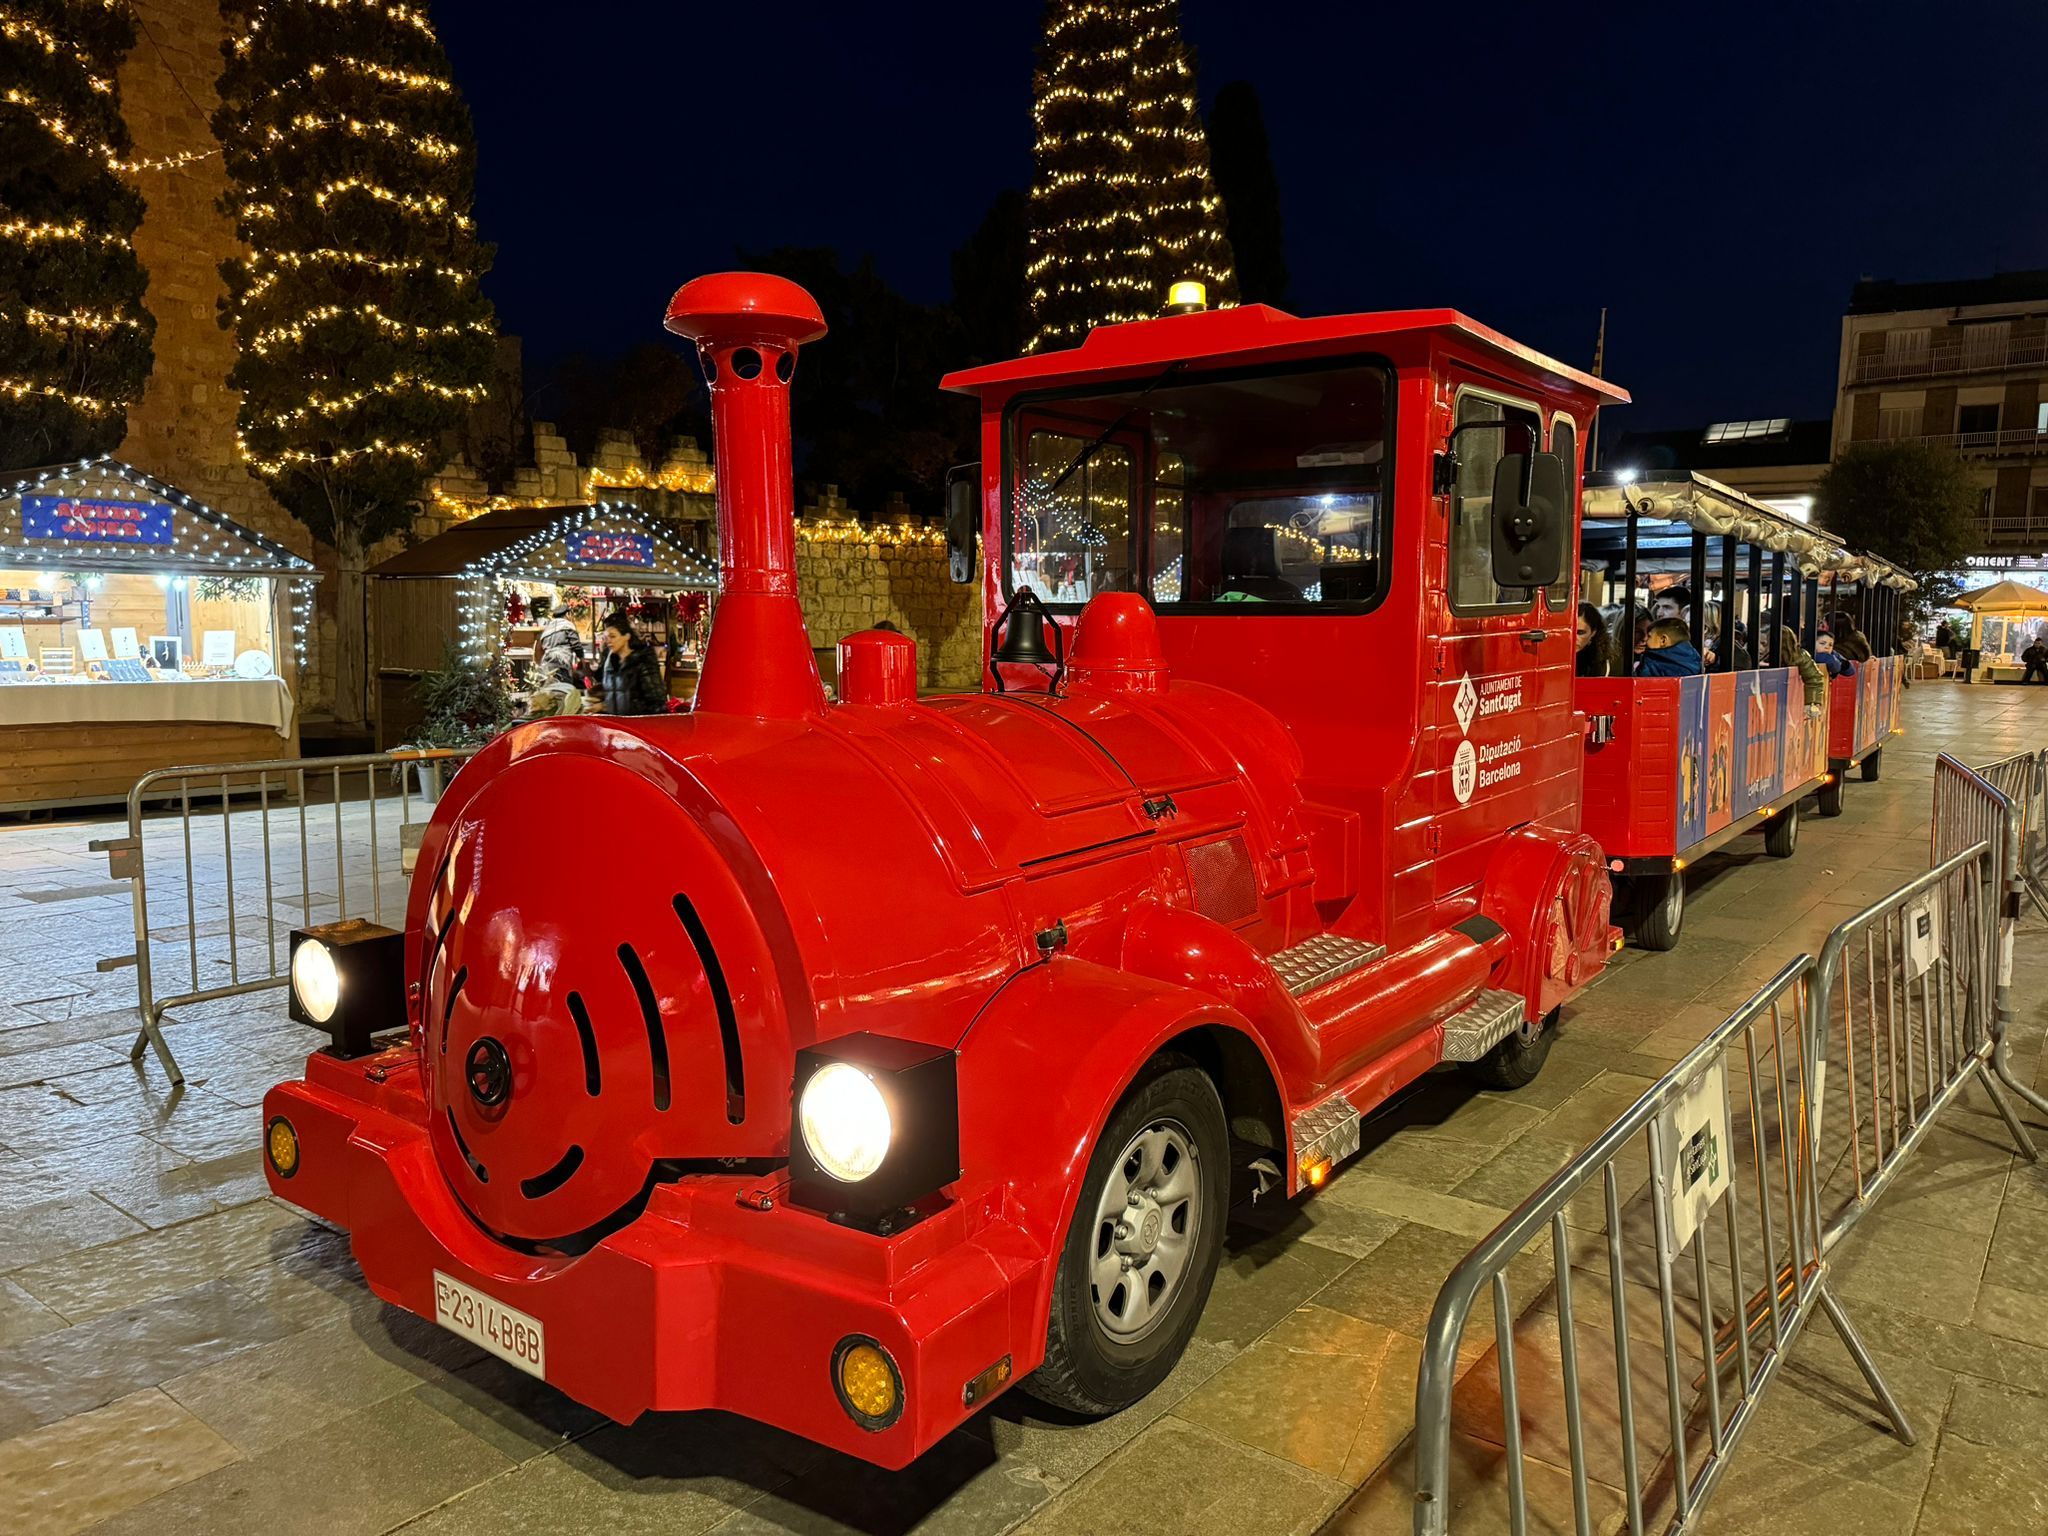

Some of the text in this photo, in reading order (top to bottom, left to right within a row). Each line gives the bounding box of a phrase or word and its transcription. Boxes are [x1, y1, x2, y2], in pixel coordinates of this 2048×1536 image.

[1965, 556, 2013, 567] ORIENT
[1480, 676, 1522, 696] AJUNTAMENT DE
[1479, 691, 1521, 715] SantCugat
[1479, 734, 1521, 765] Diputació
[1479, 762, 1521, 788] Barcelona
